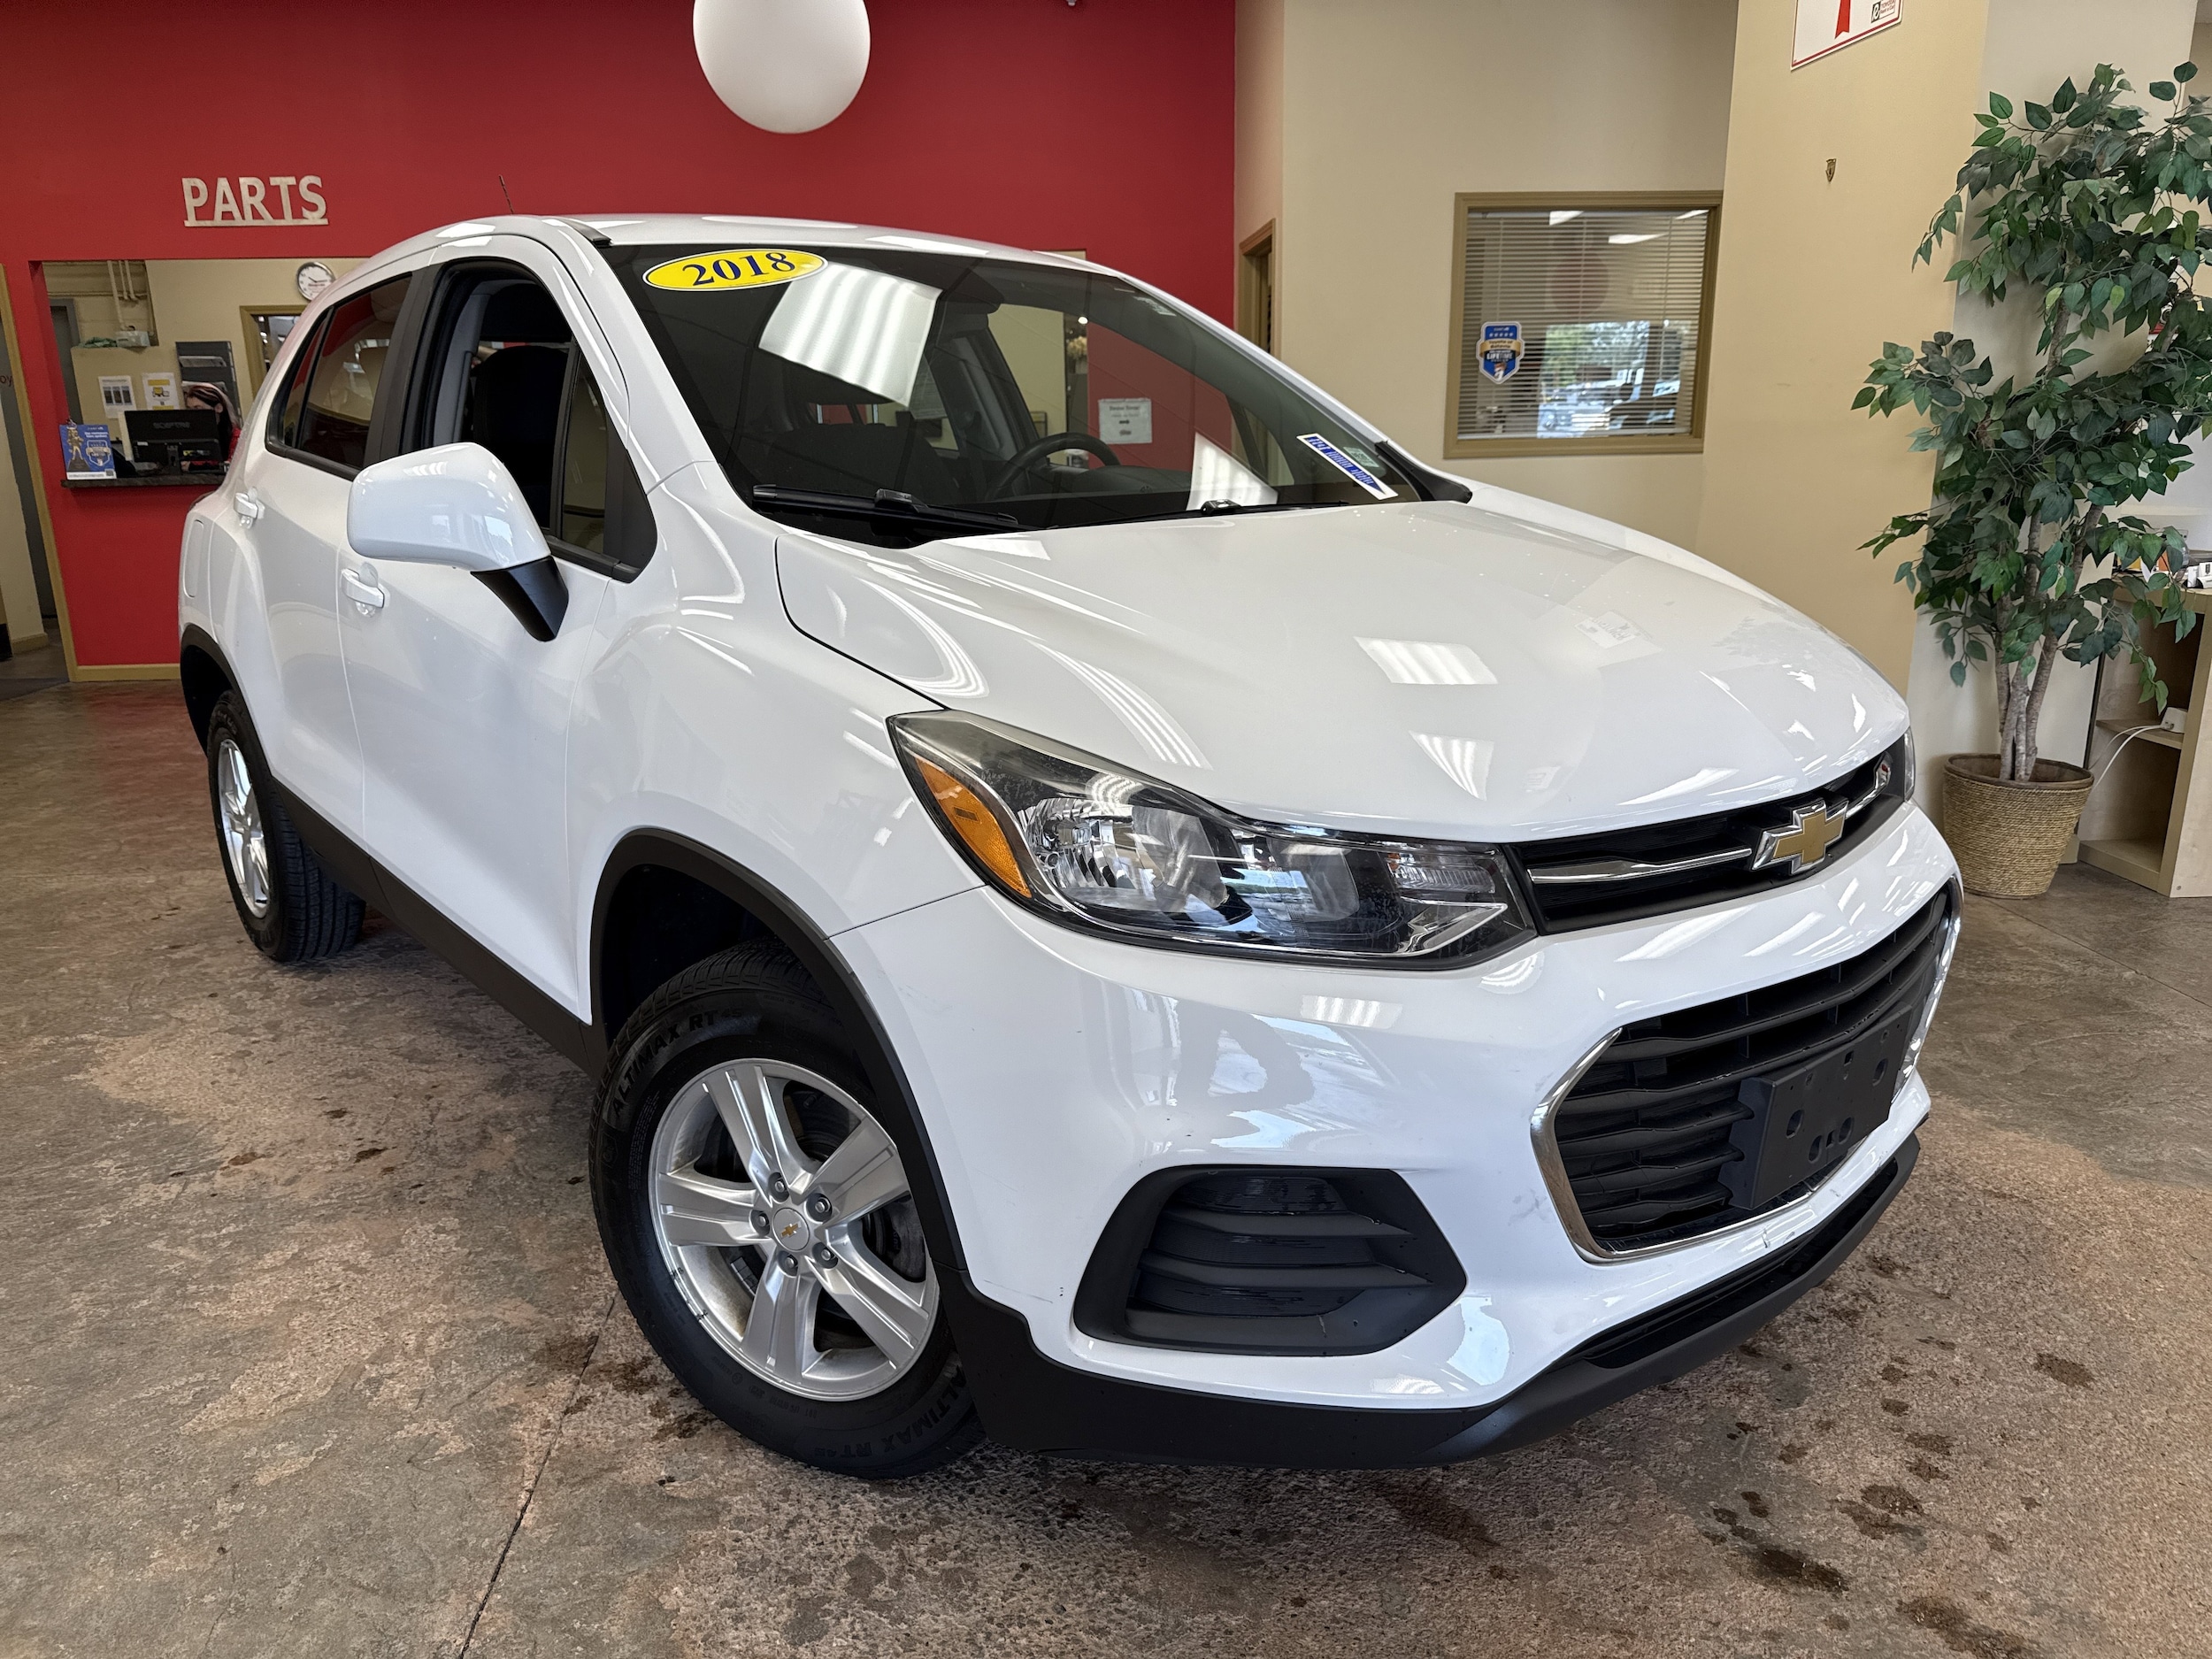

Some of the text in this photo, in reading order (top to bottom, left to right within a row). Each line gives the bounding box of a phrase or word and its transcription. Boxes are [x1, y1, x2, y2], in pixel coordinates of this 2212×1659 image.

[182, 175, 327, 225] PARTS
[682, 251, 795, 287] 2018
[612, 1025, 680, 1118] ALTIMAX
[689, 1010, 718, 1032] RT
